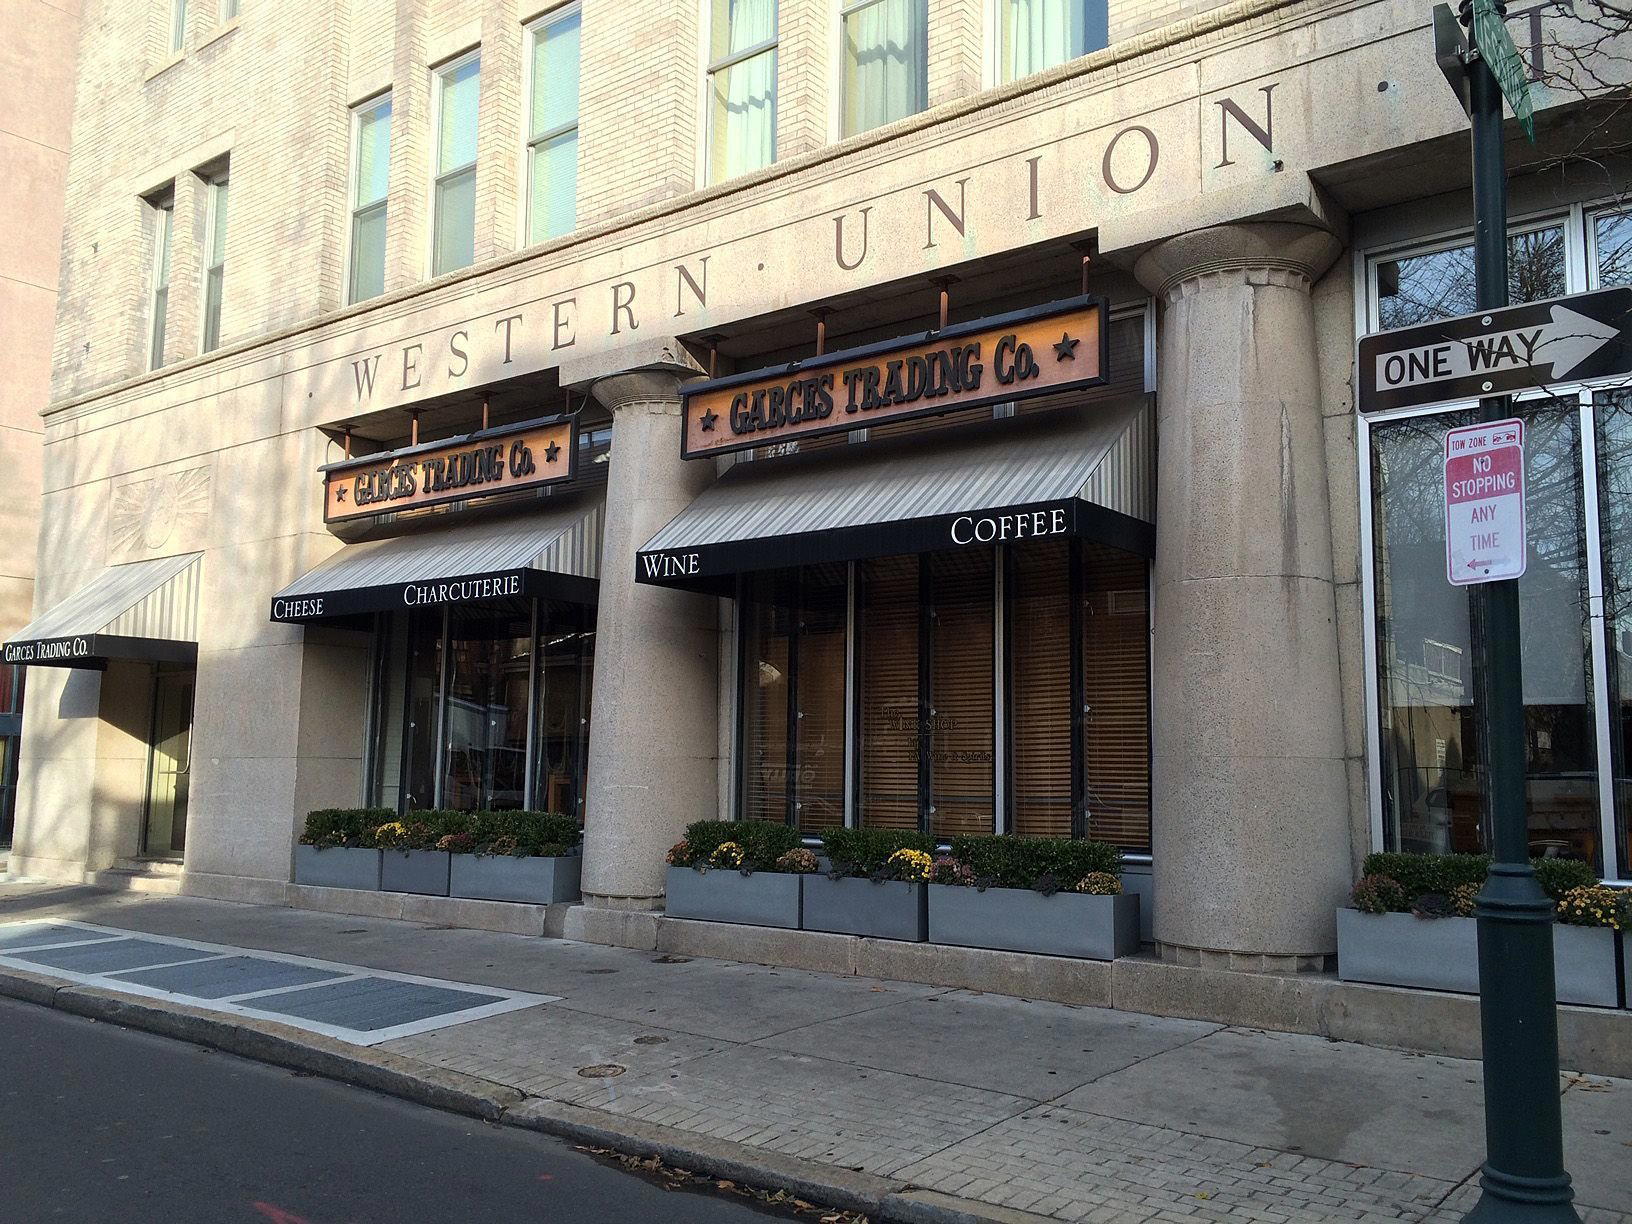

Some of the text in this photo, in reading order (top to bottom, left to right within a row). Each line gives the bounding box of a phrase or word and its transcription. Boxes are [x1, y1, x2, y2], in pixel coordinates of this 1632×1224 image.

[351, 256, 707, 401] WESTERN
[834, 84, 1277, 270] UNION
[1383, 328, 1544, 387] ONE WAY
[730, 373, 835, 435] GARCES
[842, 341, 984, 413] TRADING
[1451, 434, 1488, 452] TOW ZONE
[354, 461, 417, 507] GARCES
[421, 443, 504, 494] TRADING
[1473, 455, 1491, 475] NO
[1452, 471, 1516, 499] STOPPING
[951, 508, 1068, 545] COFFEE
[1470, 504, 1497, 524] ANY
[1470, 531, 1499, 551] TIME
[642, 552, 700, 578] WINE
[404, 575, 520, 606] CHARCUTERIE
[273, 597, 324, 618] CHEESE
[4, 643, 34, 662] GARCES
[36, 640, 71, 660] TRADING
